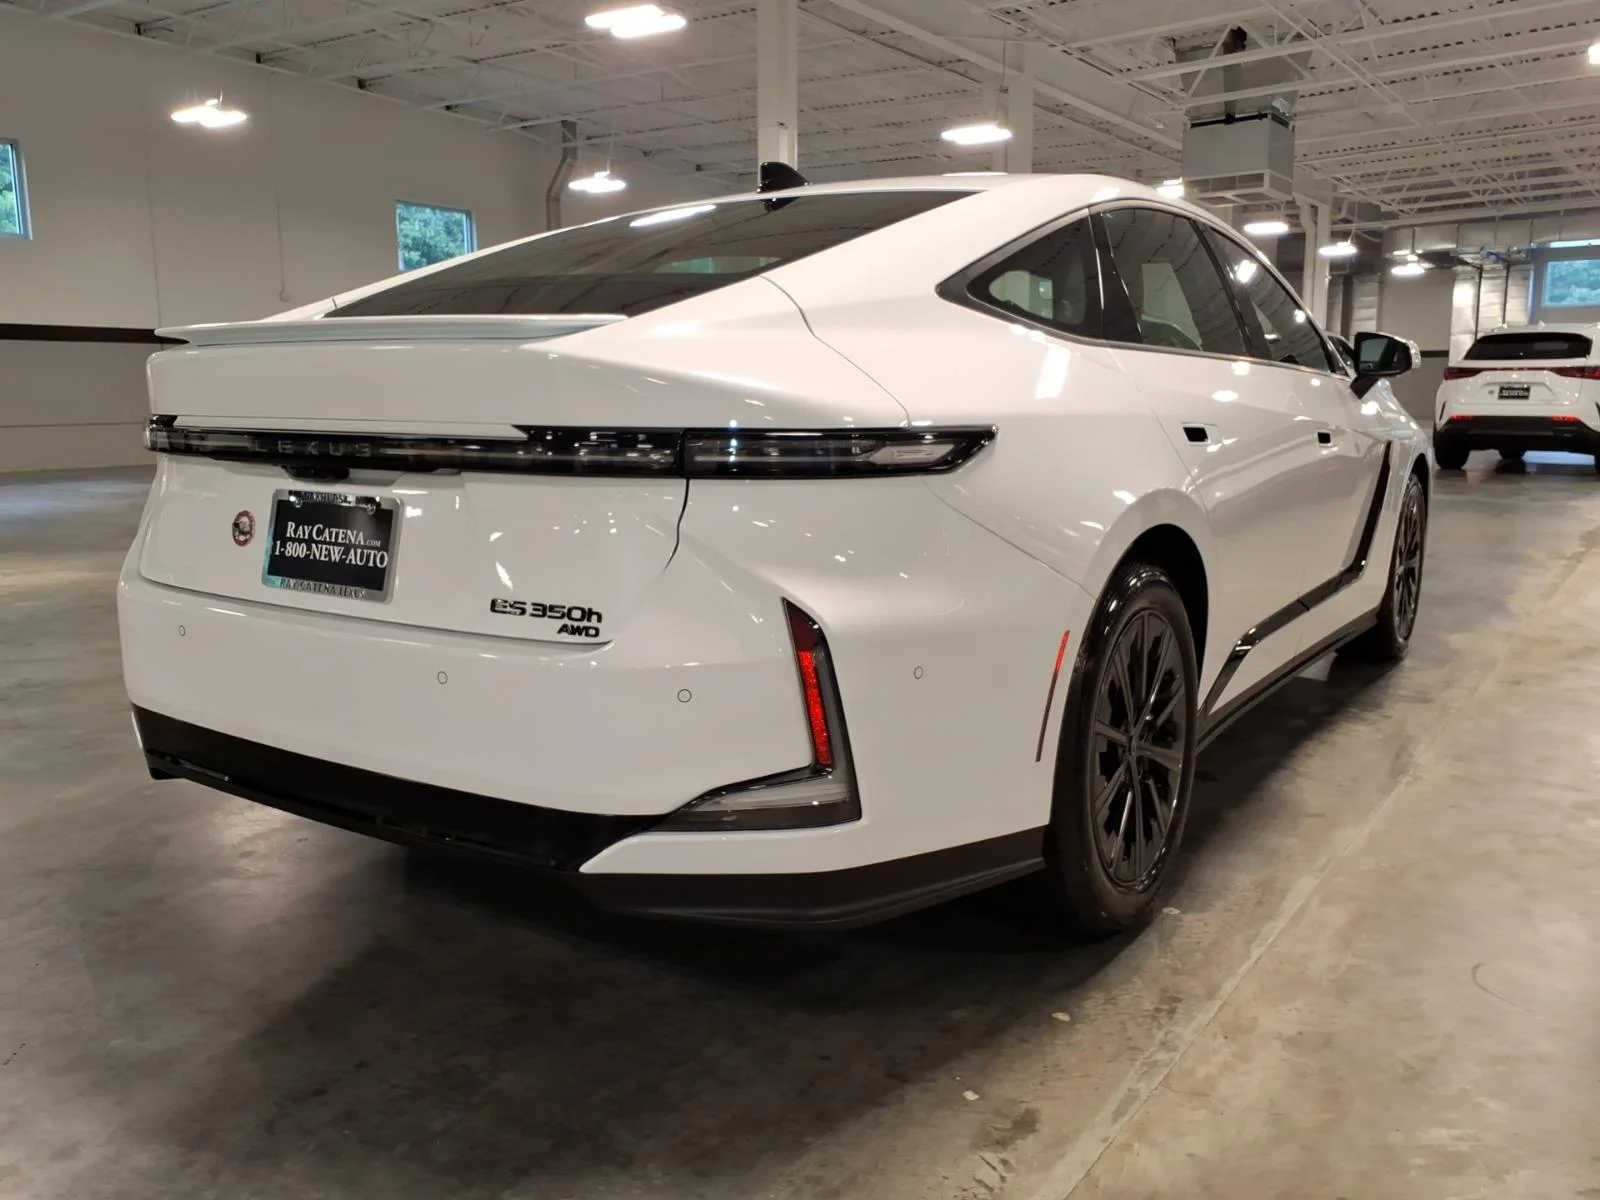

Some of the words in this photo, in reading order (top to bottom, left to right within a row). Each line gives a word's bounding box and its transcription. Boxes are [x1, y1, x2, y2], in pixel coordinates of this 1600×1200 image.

[255, 439, 371, 457] LEXUS
[275, 540, 389, 568] 1-800-NEW-AUTO
[490, 598, 527, 616] ES
[529, 602, 602, 623] 350h
[557, 623, 600, 638] AWD
